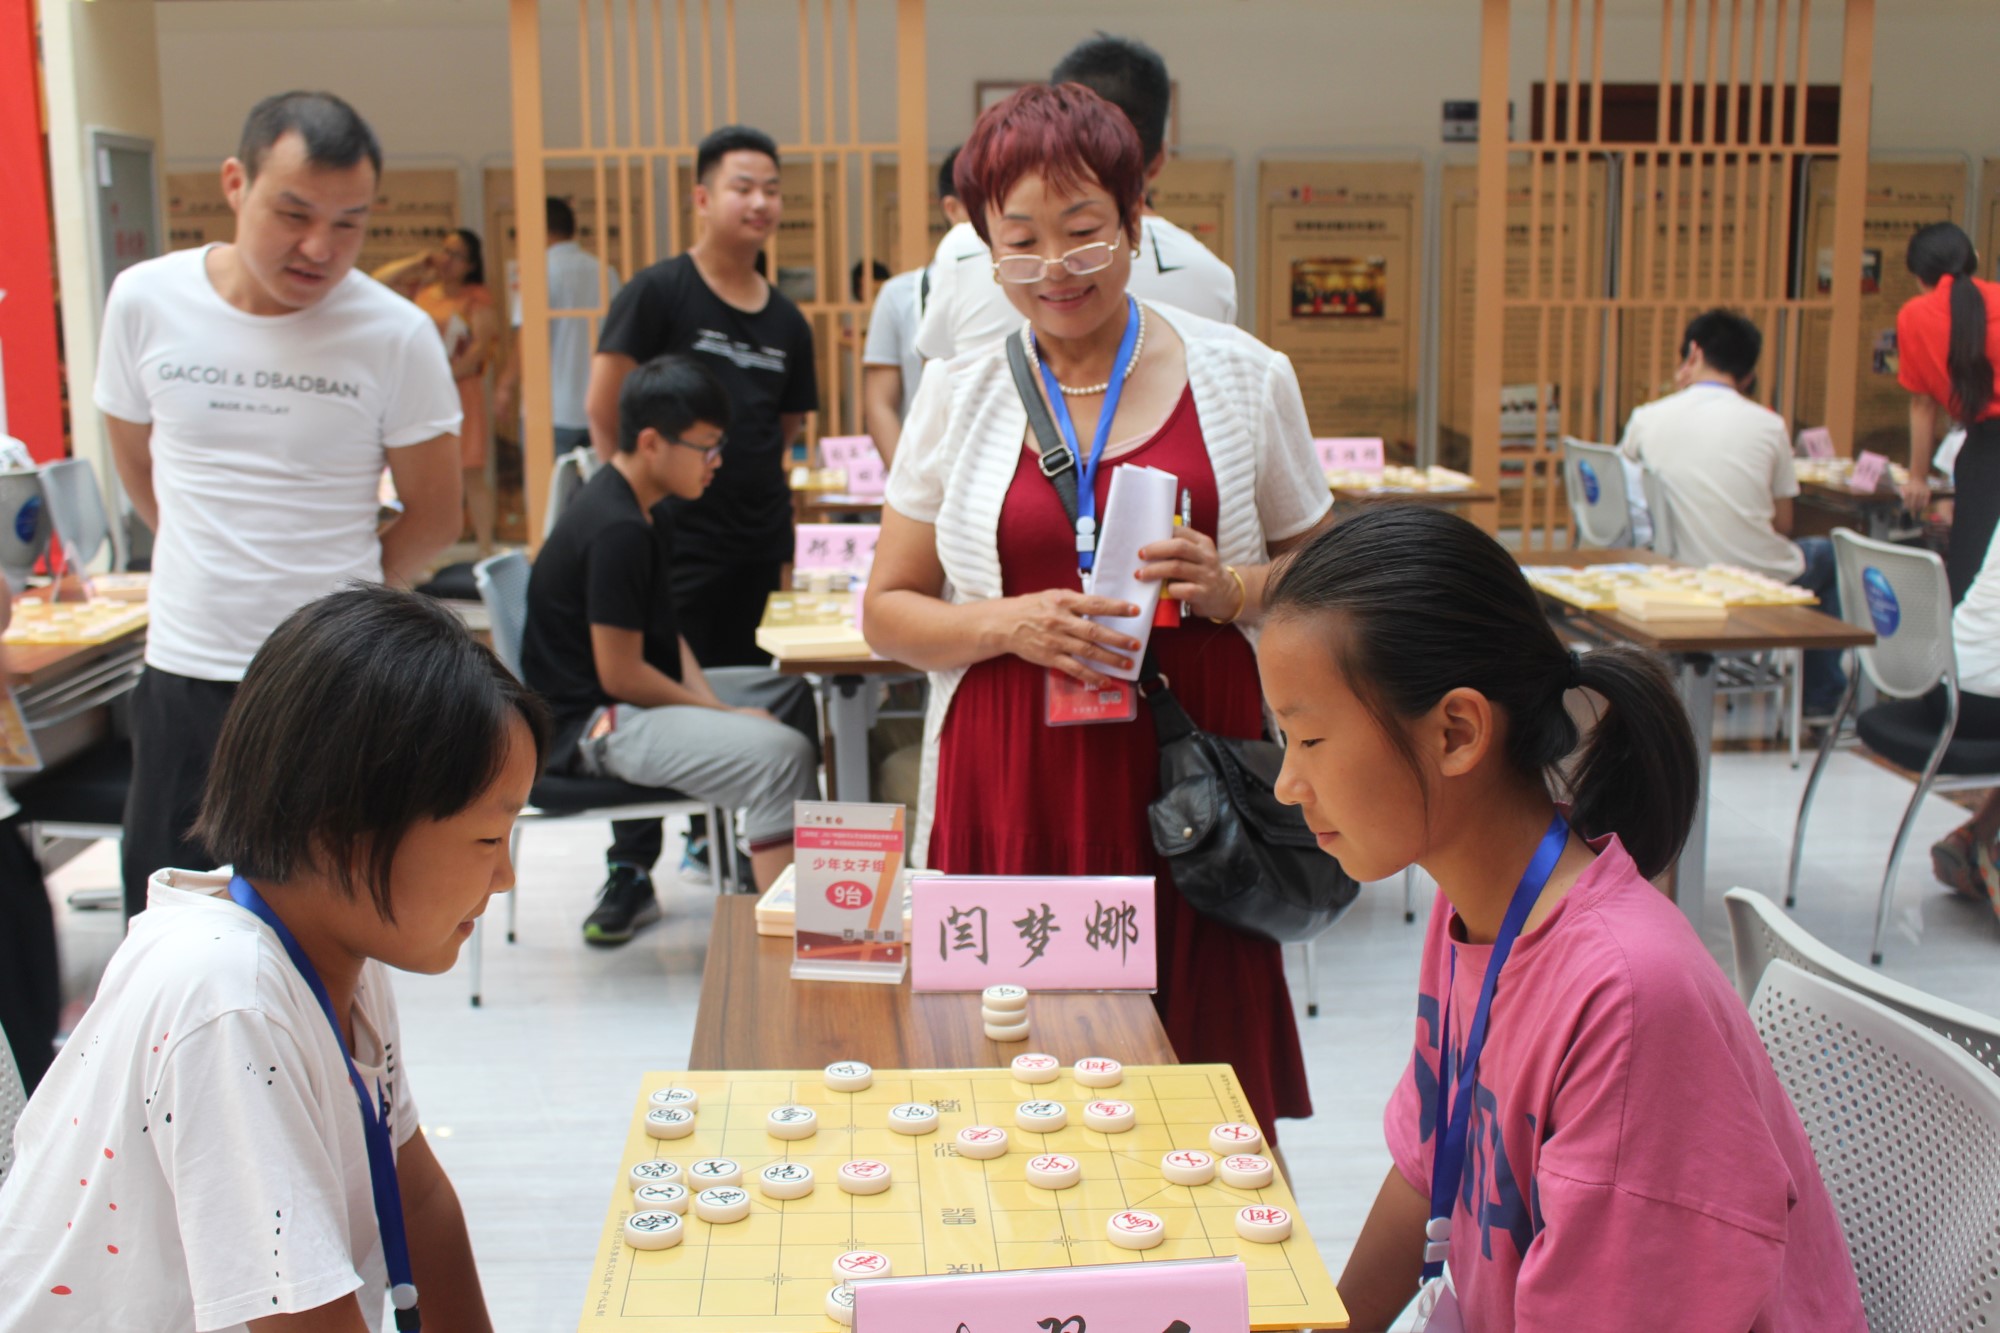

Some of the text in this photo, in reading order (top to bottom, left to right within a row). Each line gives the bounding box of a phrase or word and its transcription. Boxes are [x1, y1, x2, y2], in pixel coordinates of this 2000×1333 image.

[234, 373, 245, 386] &
[813, 857, 886, 873] 少年女子组
[834, 885, 863, 906] 9台
[939, 900, 1139, 968] 闫梦娜
